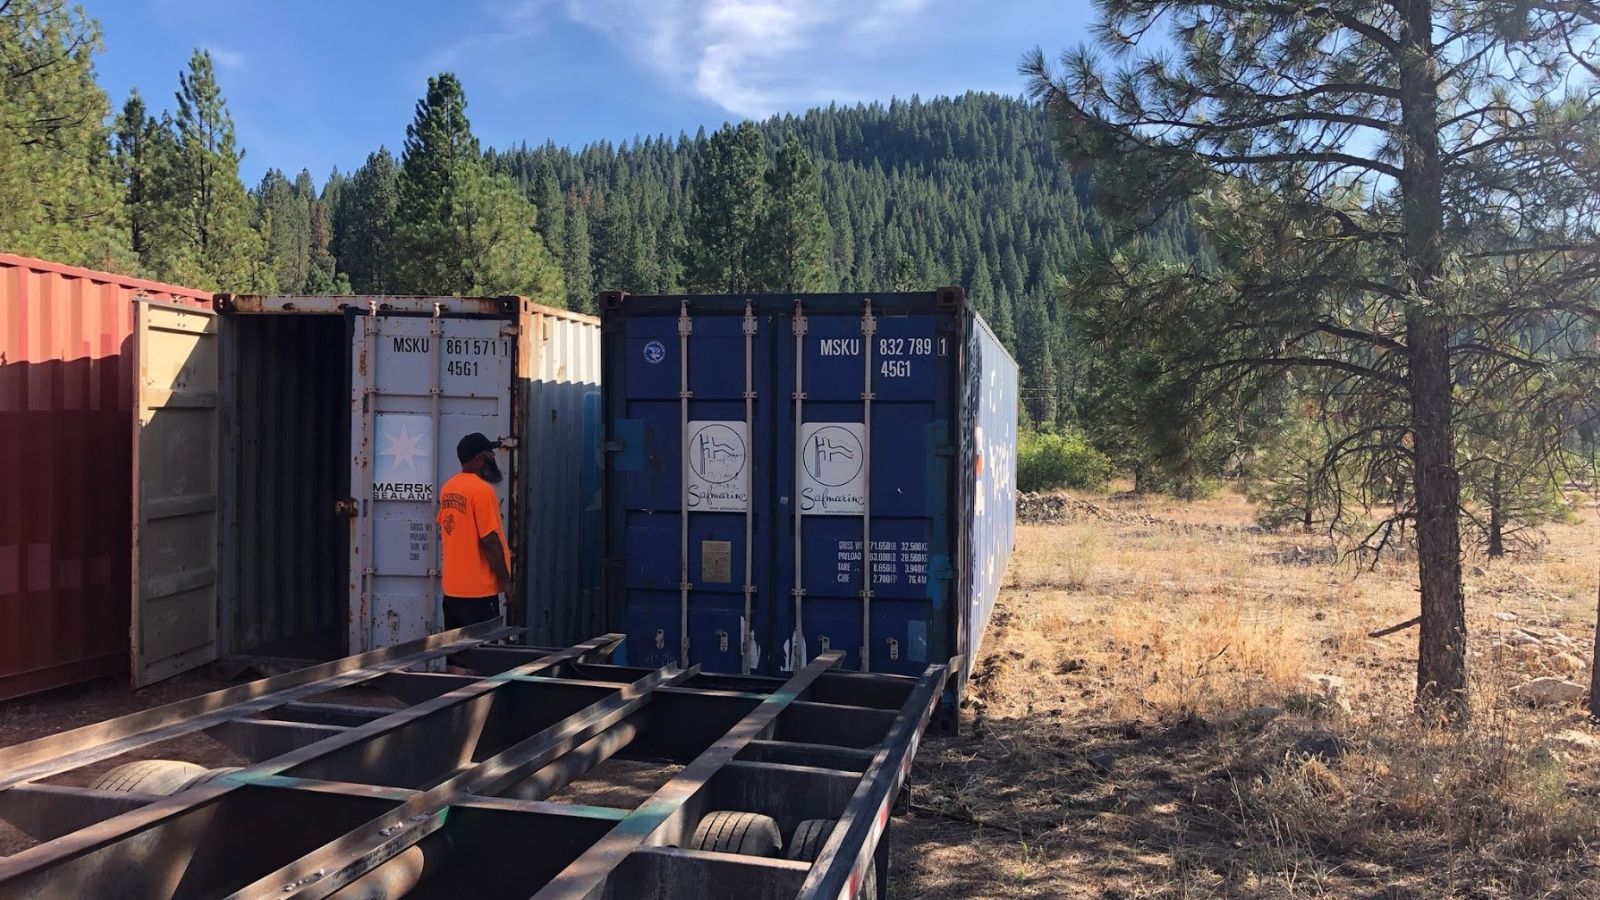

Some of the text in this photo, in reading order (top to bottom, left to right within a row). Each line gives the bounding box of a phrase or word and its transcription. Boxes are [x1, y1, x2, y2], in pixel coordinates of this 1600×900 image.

[393, 337, 430, 353] MSKU
[820, 339, 860, 356] MSKU
[879, 338, 904, 355] 832
[908, 338, 932, 355] 789
[447, 360, 478, 377] 45G1
[880, 360, 912, 378] 45G1
[373, 482, 432, 493] MAERSK
[687, 484, 749, 507] Safmarine
[800, 487, 865, 511] Safmarine
